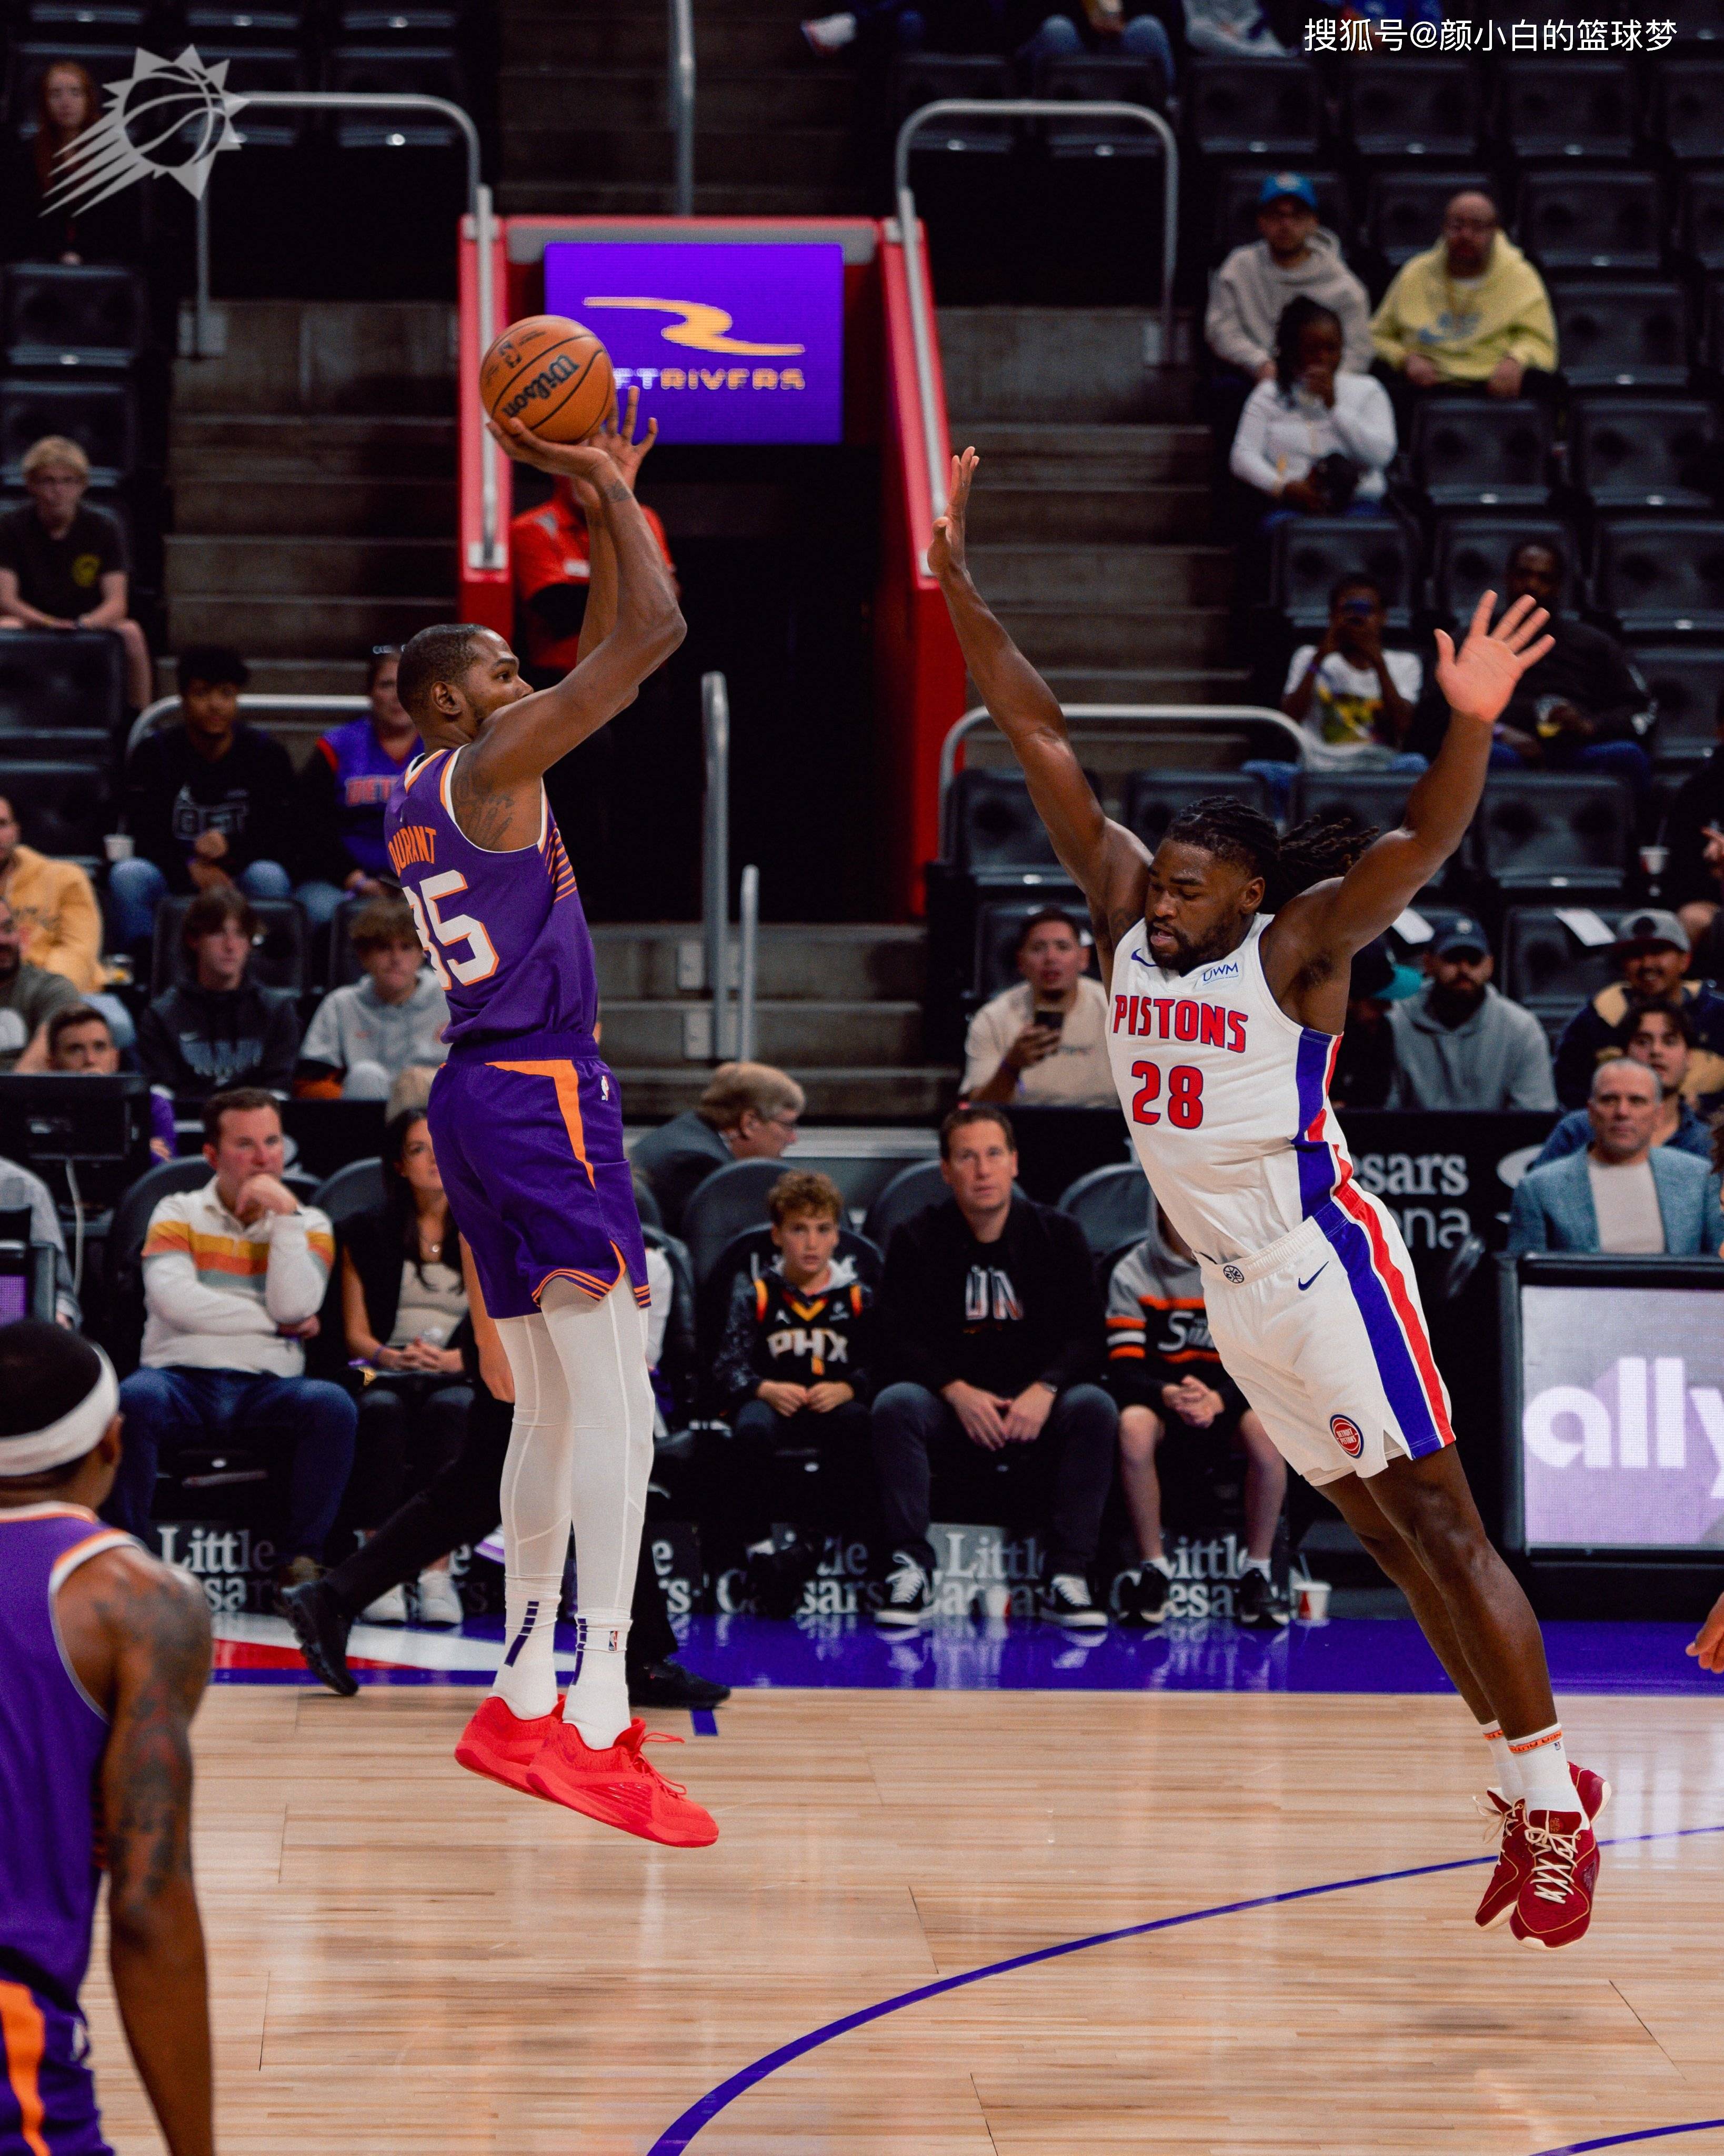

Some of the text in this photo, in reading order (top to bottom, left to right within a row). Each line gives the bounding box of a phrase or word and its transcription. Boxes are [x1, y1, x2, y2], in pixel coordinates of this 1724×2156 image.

[502, 354, 579, 417] Wilson
[613, 367, 806, 391] ETRIVERS
[388, 825, 436, 877] DURANT
[1202, 961, 1239, 982] UWM
[1113, 994, 1248, 1053] PISTONS
[1131, 1060, 1204, 1130] 28
[1351, 1153, 1470, 1196] sars
[766, 1325, 849, 1364] PHX
